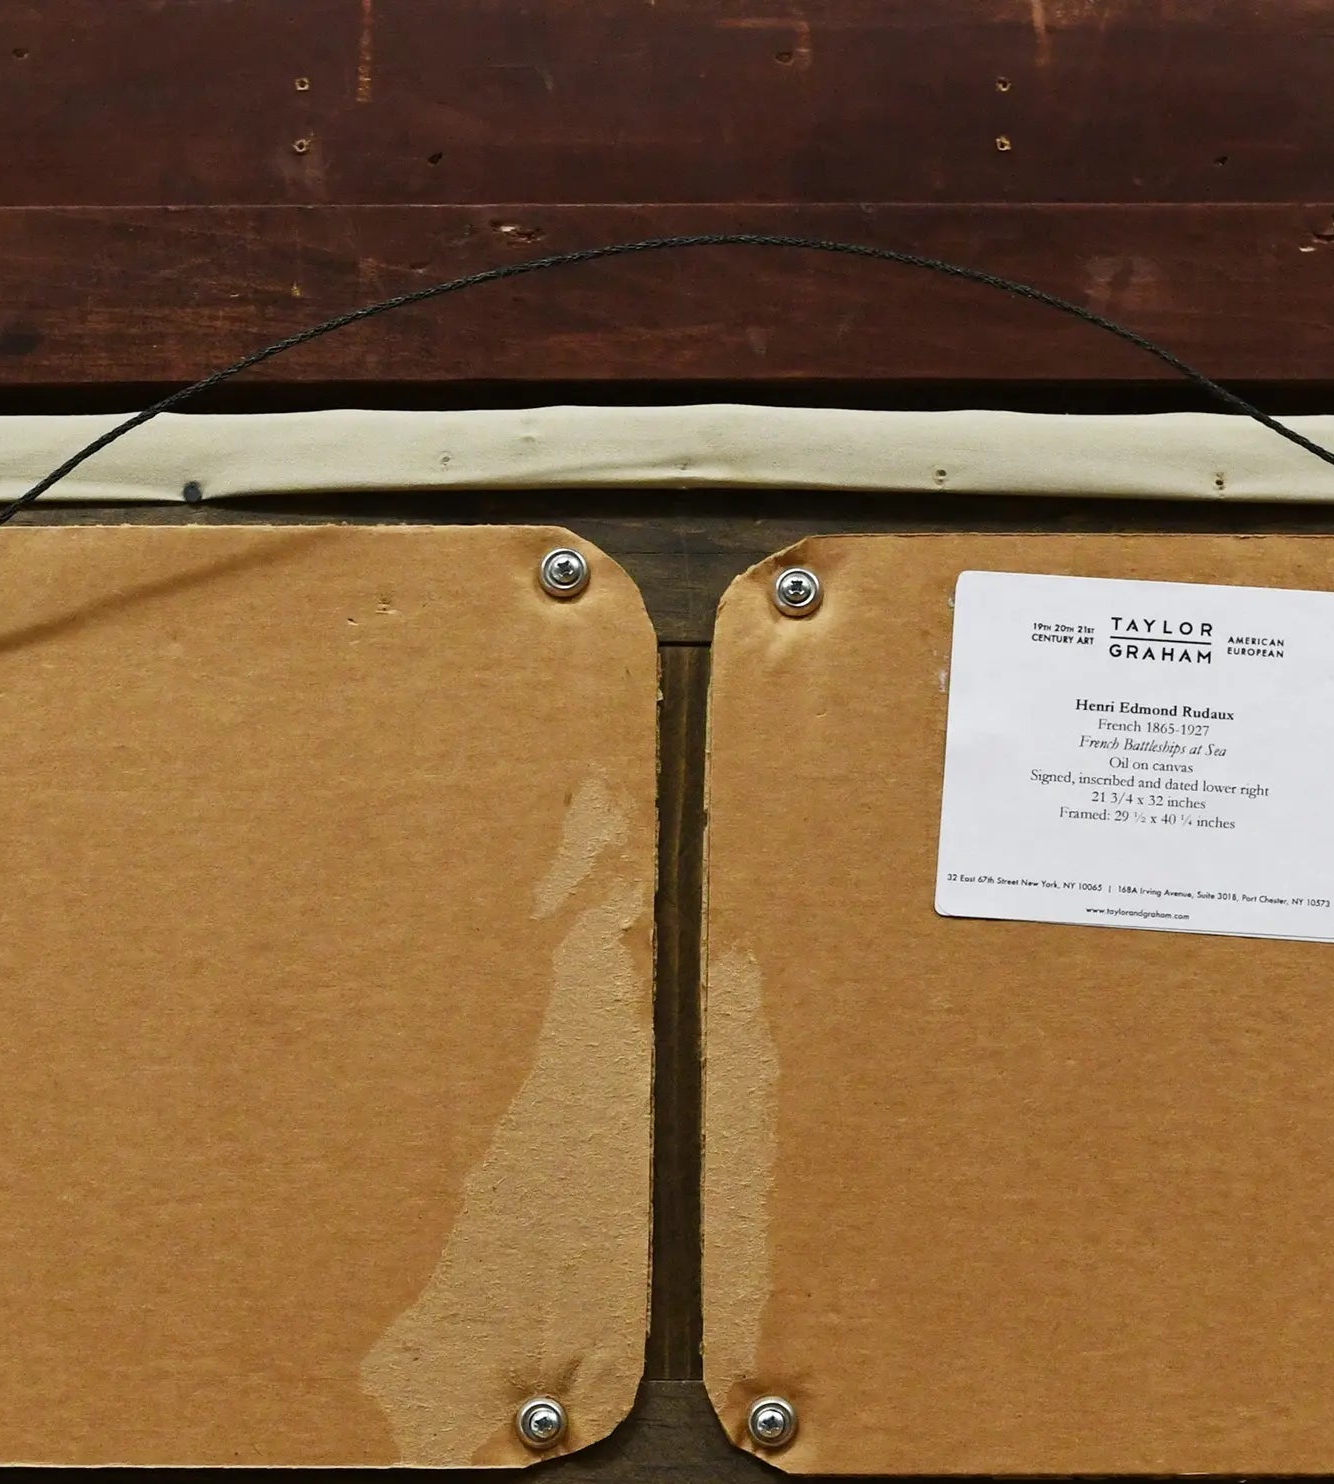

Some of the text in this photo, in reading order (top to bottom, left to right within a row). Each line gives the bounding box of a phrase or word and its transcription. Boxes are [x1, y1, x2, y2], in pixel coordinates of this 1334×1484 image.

[1111, 617, 1213, 636] TAYLOR
[1031, 633, 1094, 645] CENTURY ART
[1227, 636, 1284, 647] AMERICAN
[1109, 643, 1212, 664] GRAHAM
[1227, 647, 1284, 658] EUROPEAN
[1075, 699, 1234, 720] Henri Edmond Rudaux
[1099, 718, 1209, 736] French 1865-1927
[1079, 735, 1226, 756] French Battleships at Sea
[1109, 757, 1193, 773] Oil on canvas
[1030, 769, 1269, 799] Signed, inscribed and dated lower right
[1092, 791, 1206, 809] 21 3/4 x 32 inches
[1060, 807, 1110, 820] Framed:
[1114, 810, 1129, 822] 29
[1161, 814, 1176, 825] 40
[1197, 816, 1235, 829] inches
[946, 873, 957, 881] 32
[960, 874, 975, 882] East
[997, 877, 1019, 885] Street
[1041, 880, 1060, 889] York,
[1079, 883, 1102, 891] 10065
[1140, 888, 1162, 897] Irving
[1164, 889, 1194, 899] Avenue,
[1197, 891, 1215, 899] Suite
[1242, 894, 1257, 902] Port
[1259, 896, 1289, 905] Chester,
[1307, 899, 1330, 907] 10573
[1086, 908, 1189, 919] www.taylorandgraham.com
